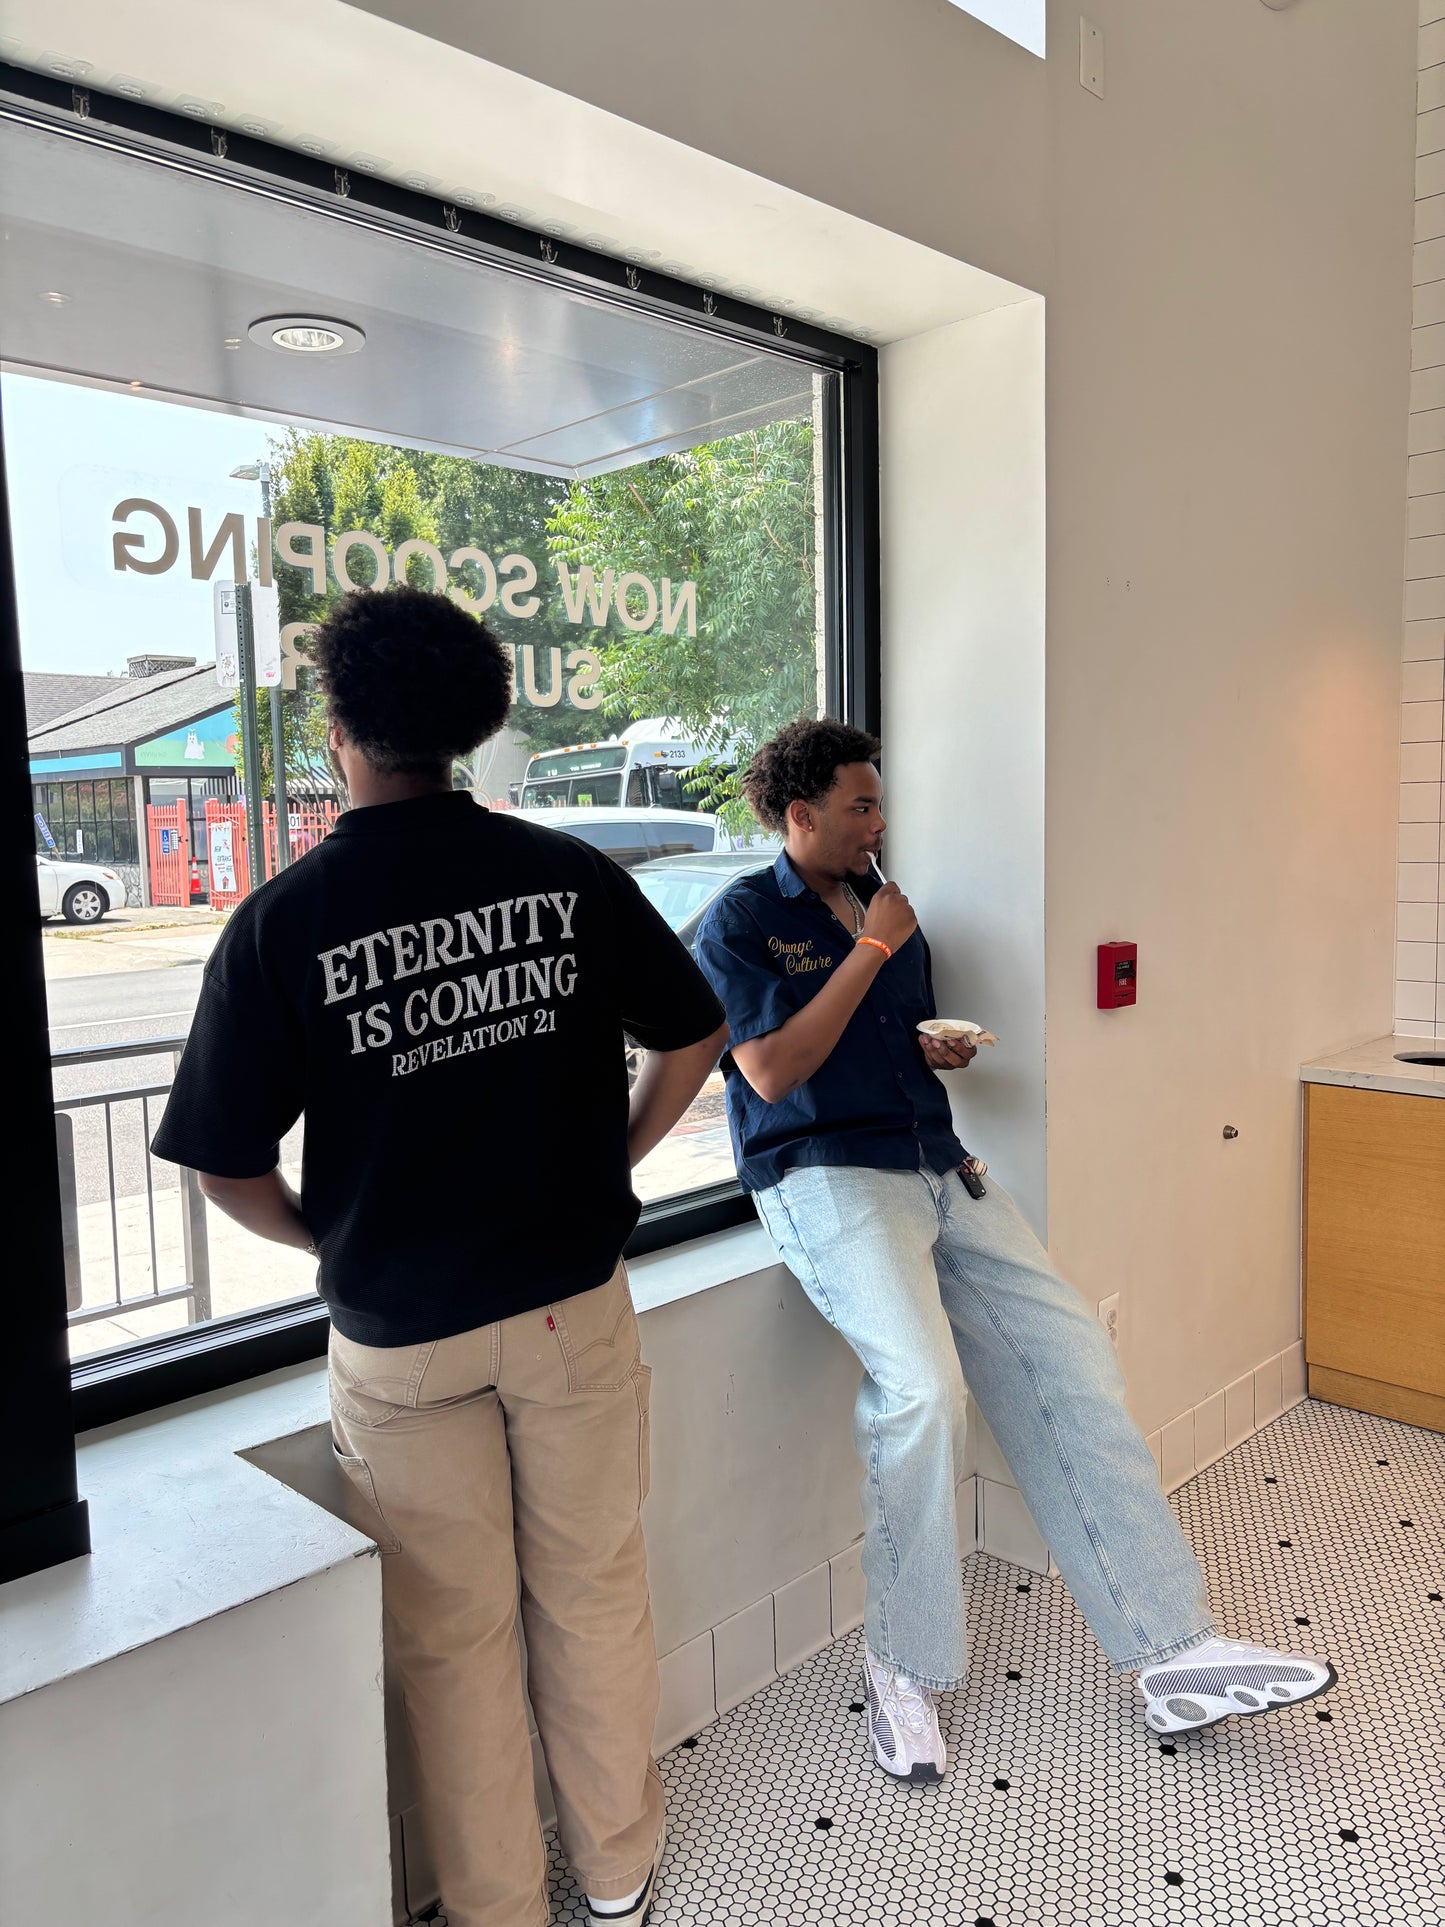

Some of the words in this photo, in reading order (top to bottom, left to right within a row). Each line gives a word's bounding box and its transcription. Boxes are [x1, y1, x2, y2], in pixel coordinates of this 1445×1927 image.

[669, 750, 686, 759] 2133
[317, 891, 579, 1006] ETERNITY
[767, 936, 814, 958] Change
[785, 954, 833, 976] Culture
[346, 1001, 393, 1055] IS
[404, 953, 579, 1036] COMING
[391, 1015, 528, 1077] REVELATION
[533, 1008, 557, 1035] 21
